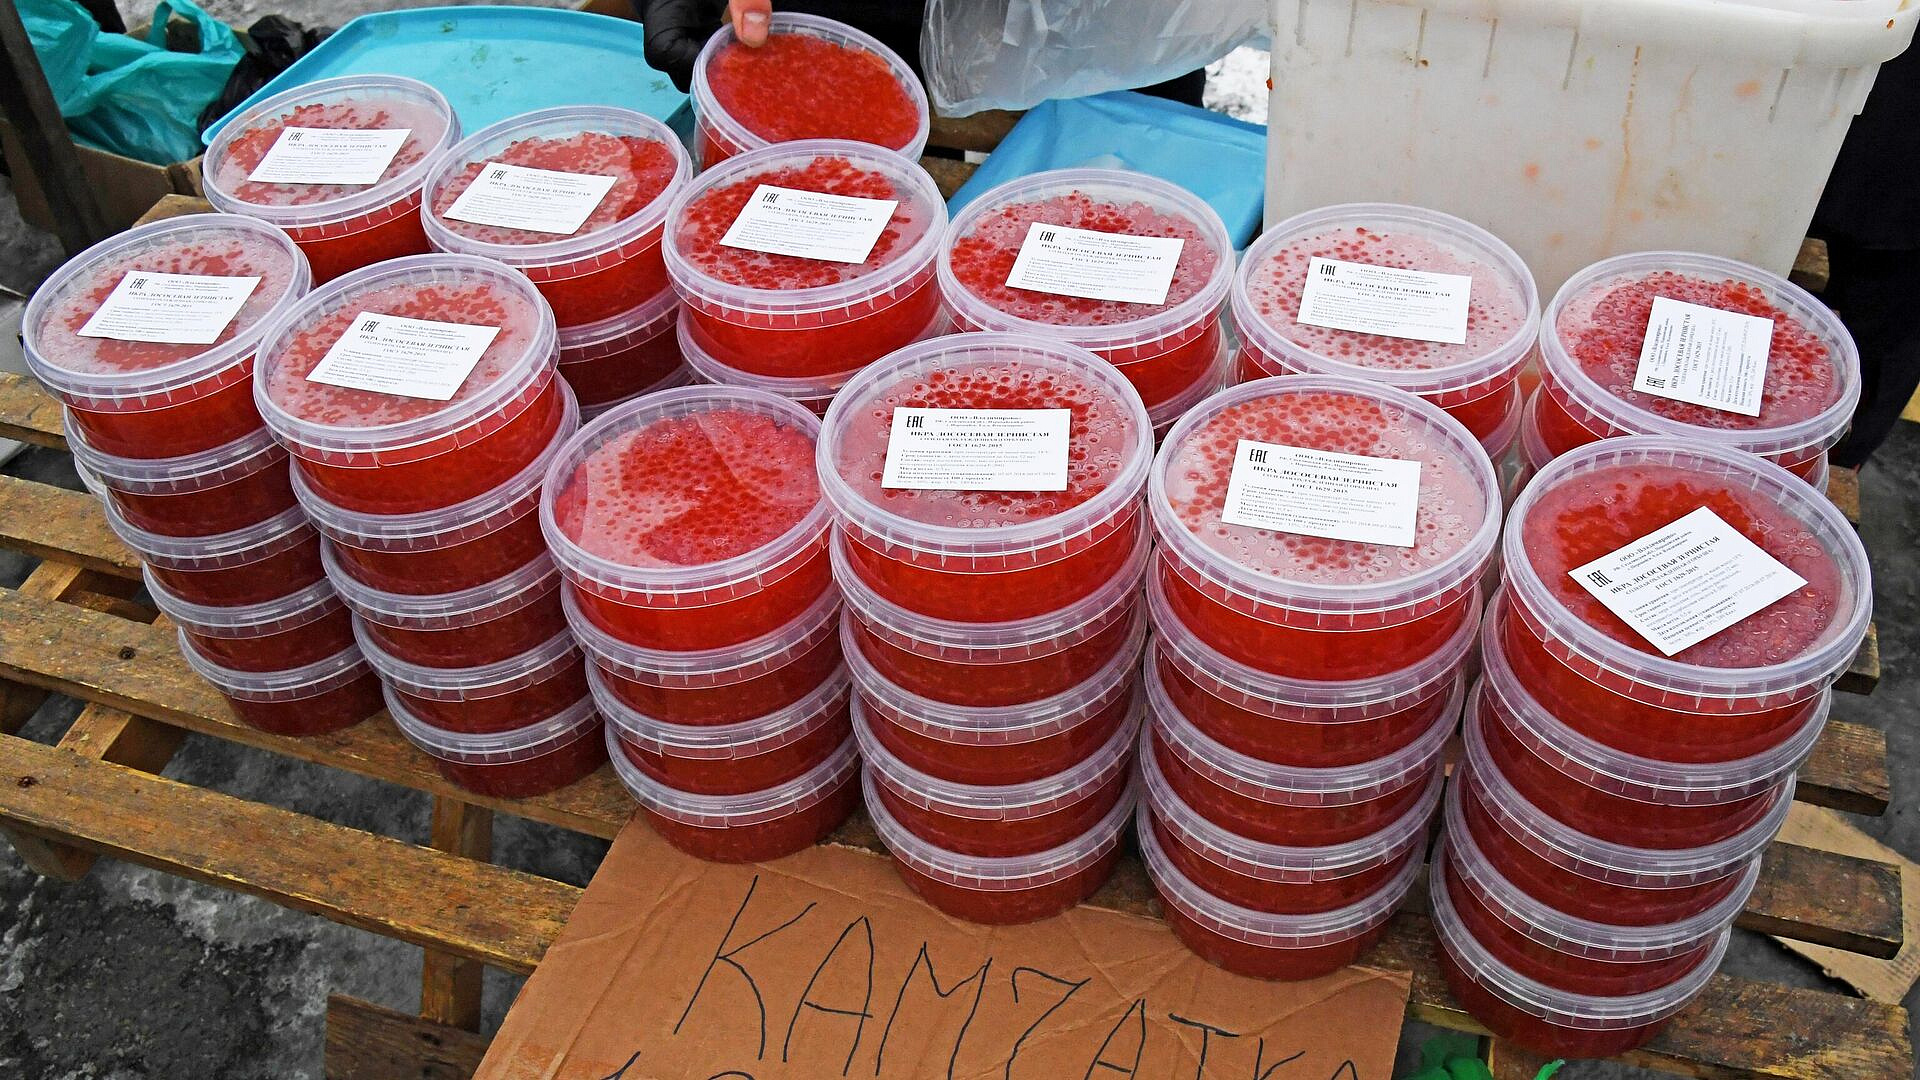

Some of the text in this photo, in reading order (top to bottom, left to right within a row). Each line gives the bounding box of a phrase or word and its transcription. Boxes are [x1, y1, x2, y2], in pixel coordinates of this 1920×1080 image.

[761, 192, 780, 203] EAC
[1038, 231, 1057, 242] EAC
[1319, 264, 1337, 276] EAC
[128, 278, 149, 288] EAC
[359, 320, 381, 332] EAC
[1645, 375, 1665, 388] EAC
[905, 415, 924, 427] EAC
[1248, 448, 1268, 463] EAC
[1252, 465, 1278, 473] ИКРА
[1279, 468, 1339, 481] ЛОСОСЕВАЯ
[1341, 476, 1398, 489] ЗЕРНИСТАЯ
[1608, 580, 1633, 594] ИКРА
[1629, 557, 1679, 584] ЛОСОСЕВАЯ
[1674, 535, 1722, 561] ЗЕРНИСТАЯ
[1585, 569, 1613, 588] EAC
[1654, 565, 1701, 590] ГОСТ 1629-2015
[673, 874, 1359, 1080] КАМЧАТК
